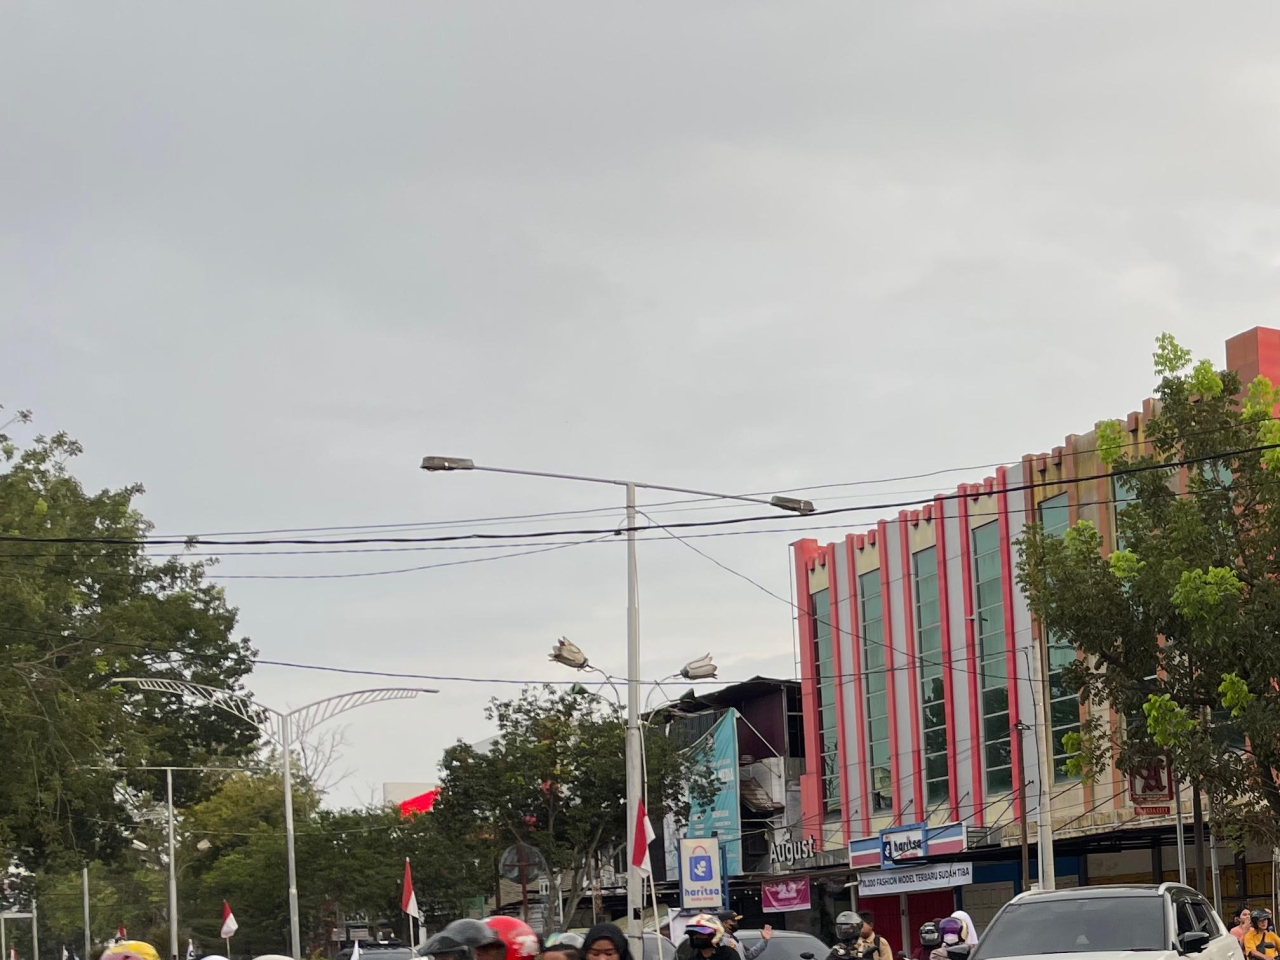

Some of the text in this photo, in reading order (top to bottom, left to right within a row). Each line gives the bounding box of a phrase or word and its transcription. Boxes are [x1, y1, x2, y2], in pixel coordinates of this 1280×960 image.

[769, 834, 815, 866] August
[893, 835, 922, 853] haritsa
[876, 876, 897, 886] FASHION
[897, 873, 916, 884] MODEL
[915, 870, 938, 883] TERBARU
[938, 868, 957, 881] SUDAH
[957, 866, 970, 878] TIBA
[684, 885, 720, 897] haritsa
